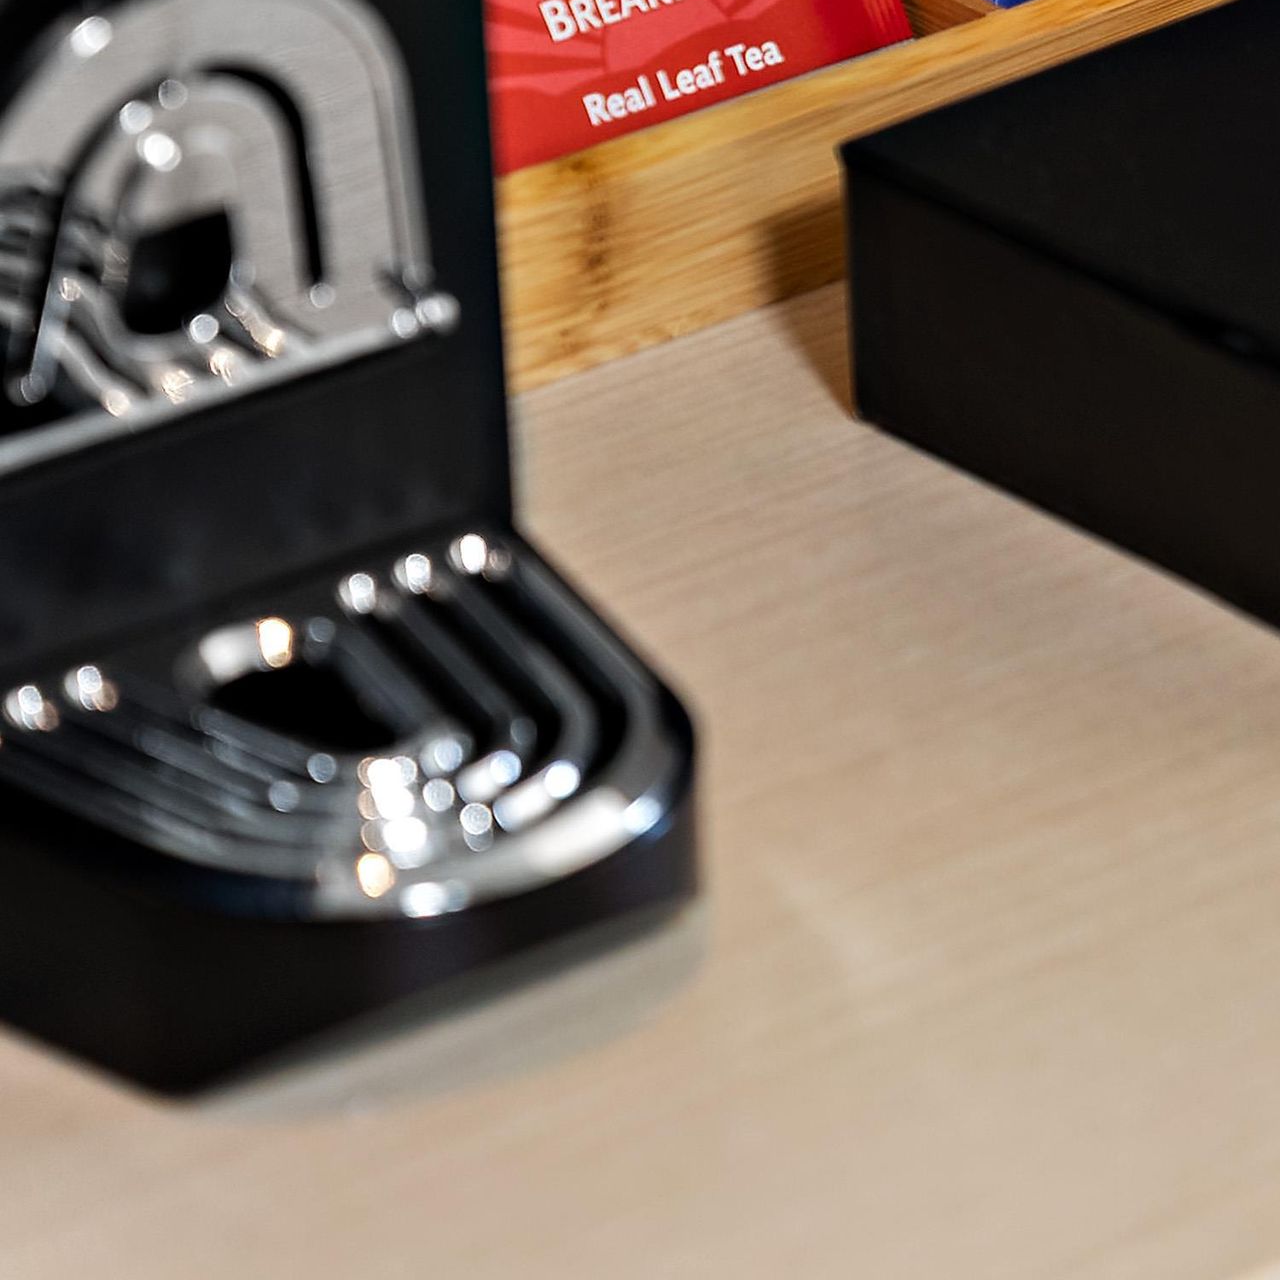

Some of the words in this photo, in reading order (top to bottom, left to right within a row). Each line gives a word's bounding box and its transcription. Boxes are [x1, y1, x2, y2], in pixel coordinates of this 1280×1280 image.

[583, 76, 657, 126] Real
[658, 49, 726, 102] Leaf
[724, 38, 785, 74] Tea
